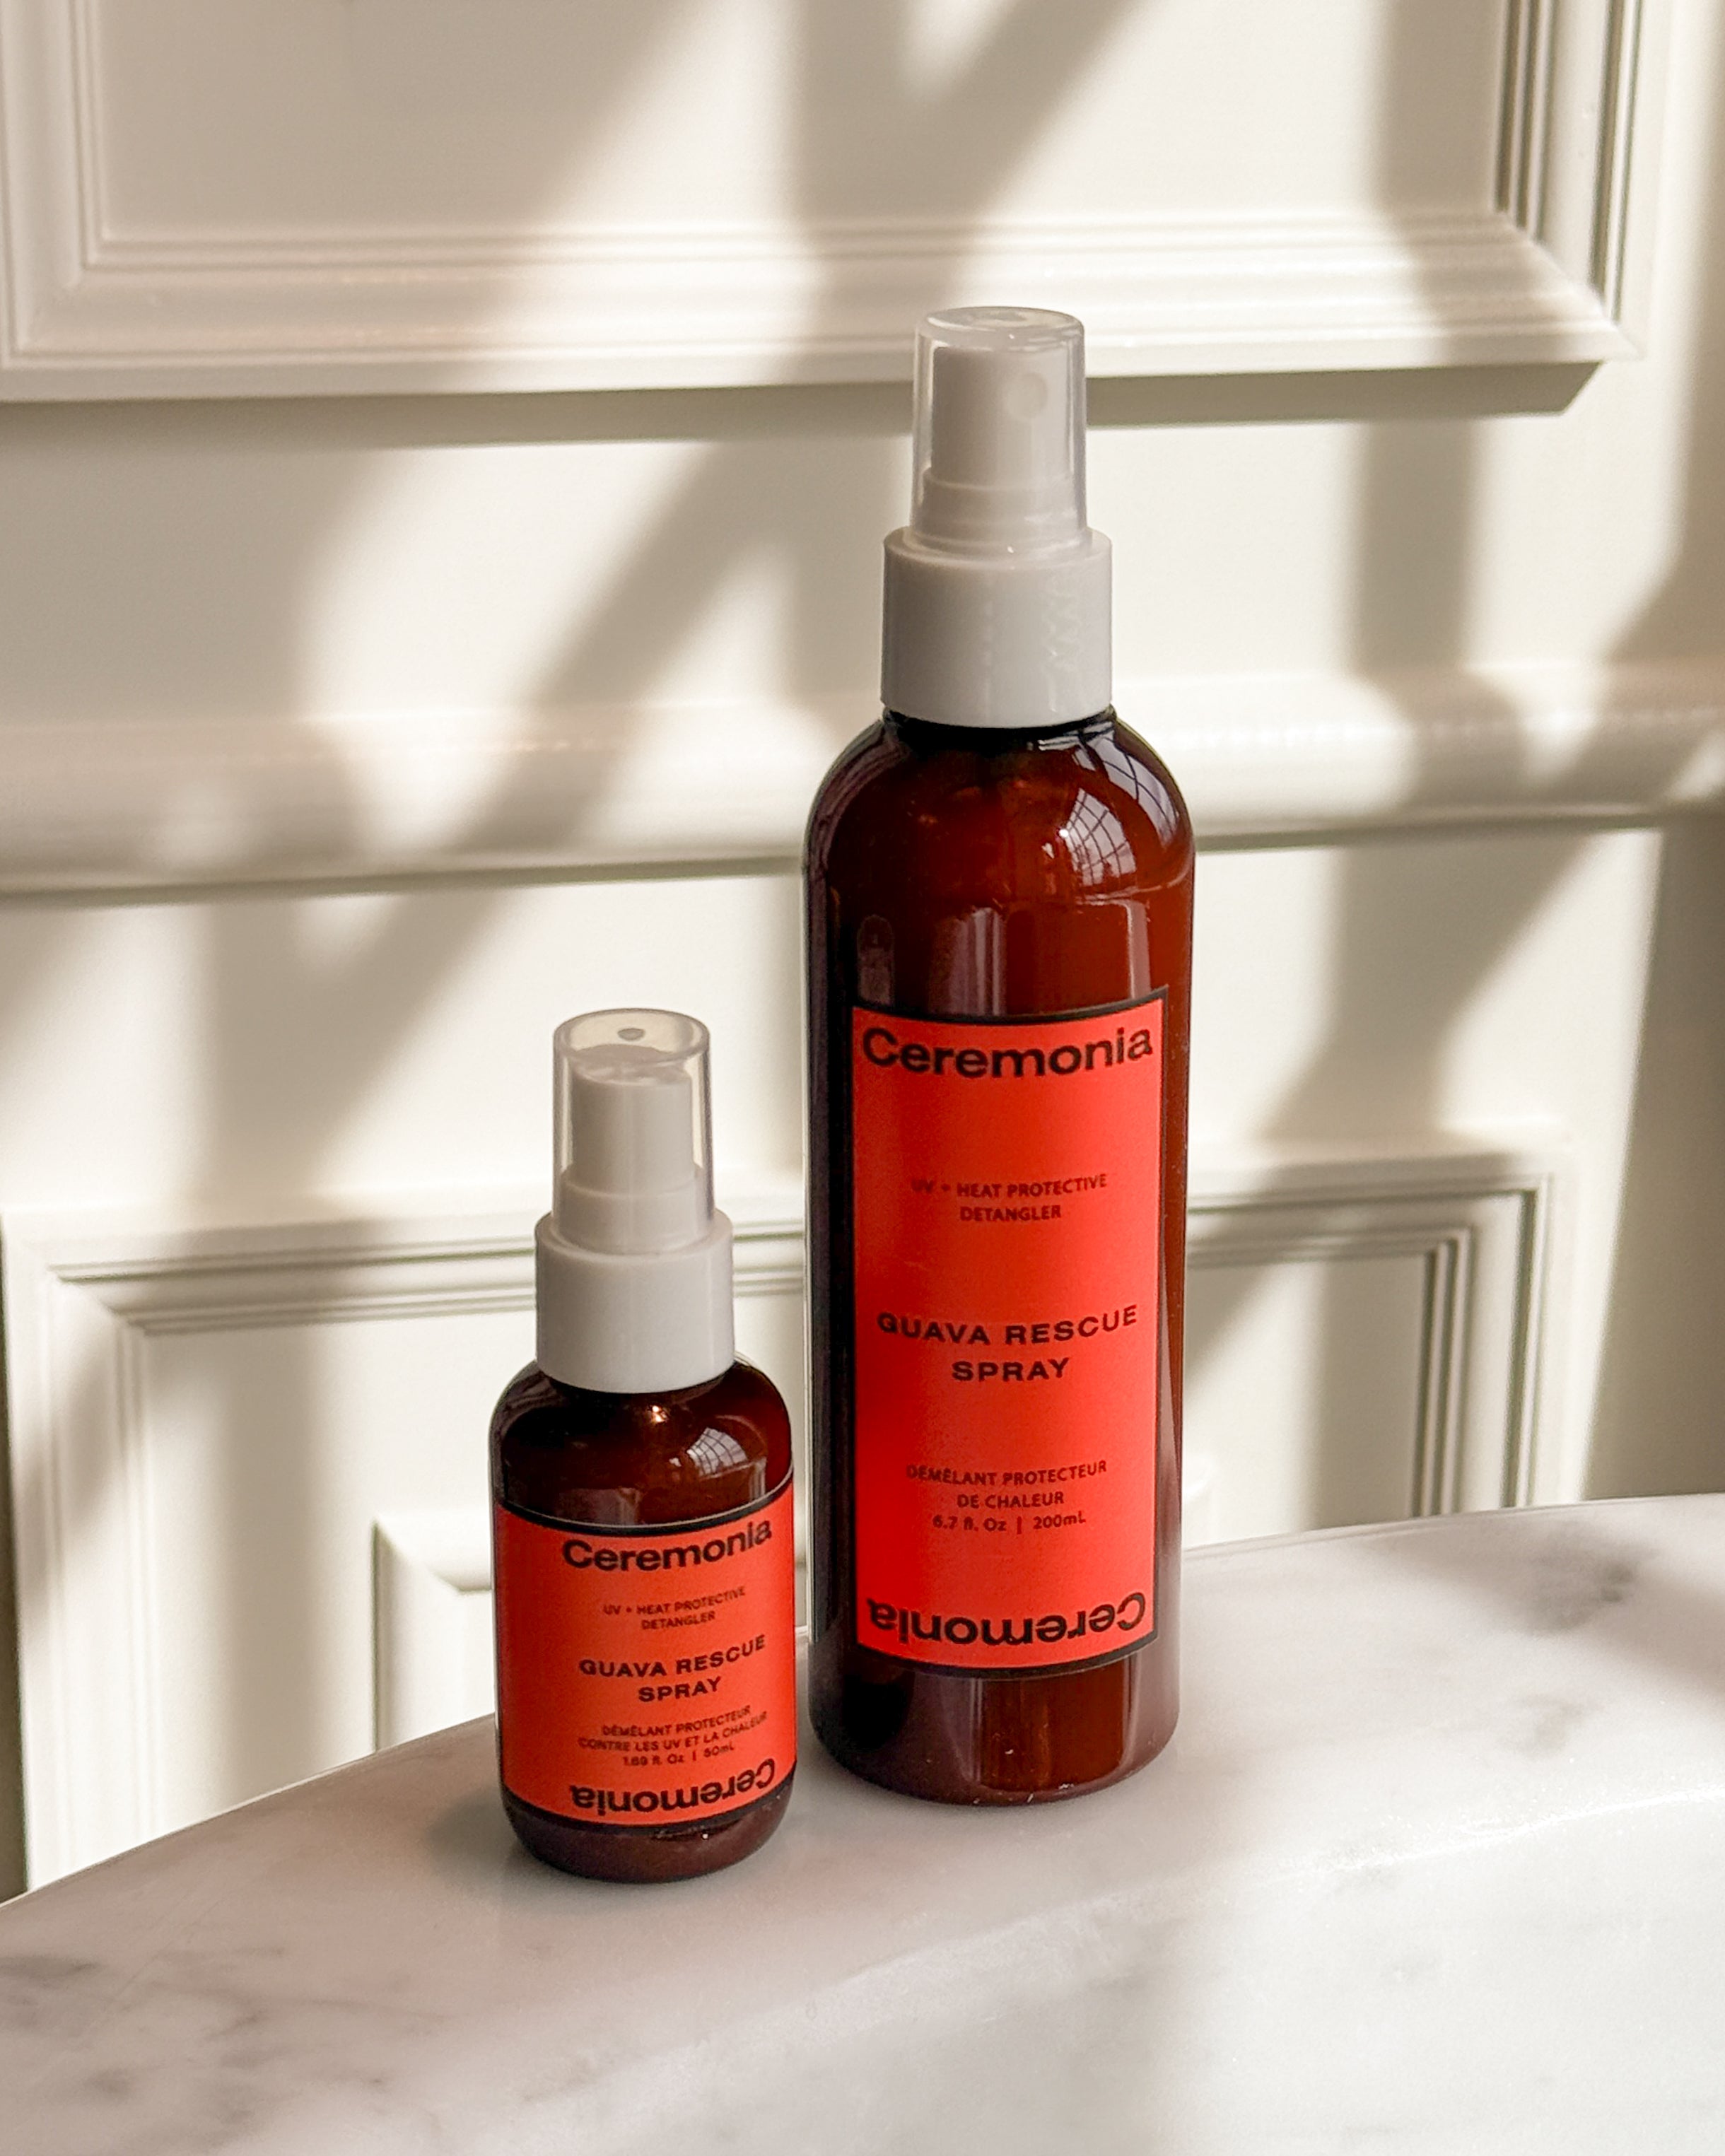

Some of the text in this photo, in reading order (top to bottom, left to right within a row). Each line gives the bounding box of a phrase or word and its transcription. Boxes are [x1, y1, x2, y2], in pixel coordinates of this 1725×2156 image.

[862, 1027, 1153, 1078] Ceremonia
[957, 1183, 1002, 1197] HEAT
[1007, 1173, 1107, 1197] PROTECTIVE
[960, 1205, 1062, 1221] DETANGLER
[877, 1304, 1138, 1345] GUAVA RESCUE
[952, 1357, 1070, 1382] SPRAY
[1002, 1460, 1107, 1486] PROTECTEUR
[957, 1491, 1065, 1510] DE CHALEUR
[932, 1515, 958, 1530] 6.7
[983, 1518, 1007, 1532] Oz
[1033, 1511, 1087, 1530] 200mL
[563, 1520, 772, 1571] Ceremonia
[603, 1604, 621, 1615] UV
[636, 1603, 671, 1615] HEAT
[674, 1586, 746, 1612] PROTECTIVE
[641, 1610, 716, 1630] DETANGLER
[866, 1592, 1147, 1646] Ceremonia
[579, 1634, 766, 1678] GUAVA RESCUE
[638, 1676, 722, 1703] SPRAY
[676, 1704, 751, 1734] PROTECTEUR
[578, 1737, 631, 1752] CONTRE
[635, 1741, 659, 1752] LES
[663, 1739, 681, 1750] UV
[685, 1735, 699, 1747] ET
[703, 1731, 720, 1743] LA
[569, 1758, 776, 1817] Ceremonia
